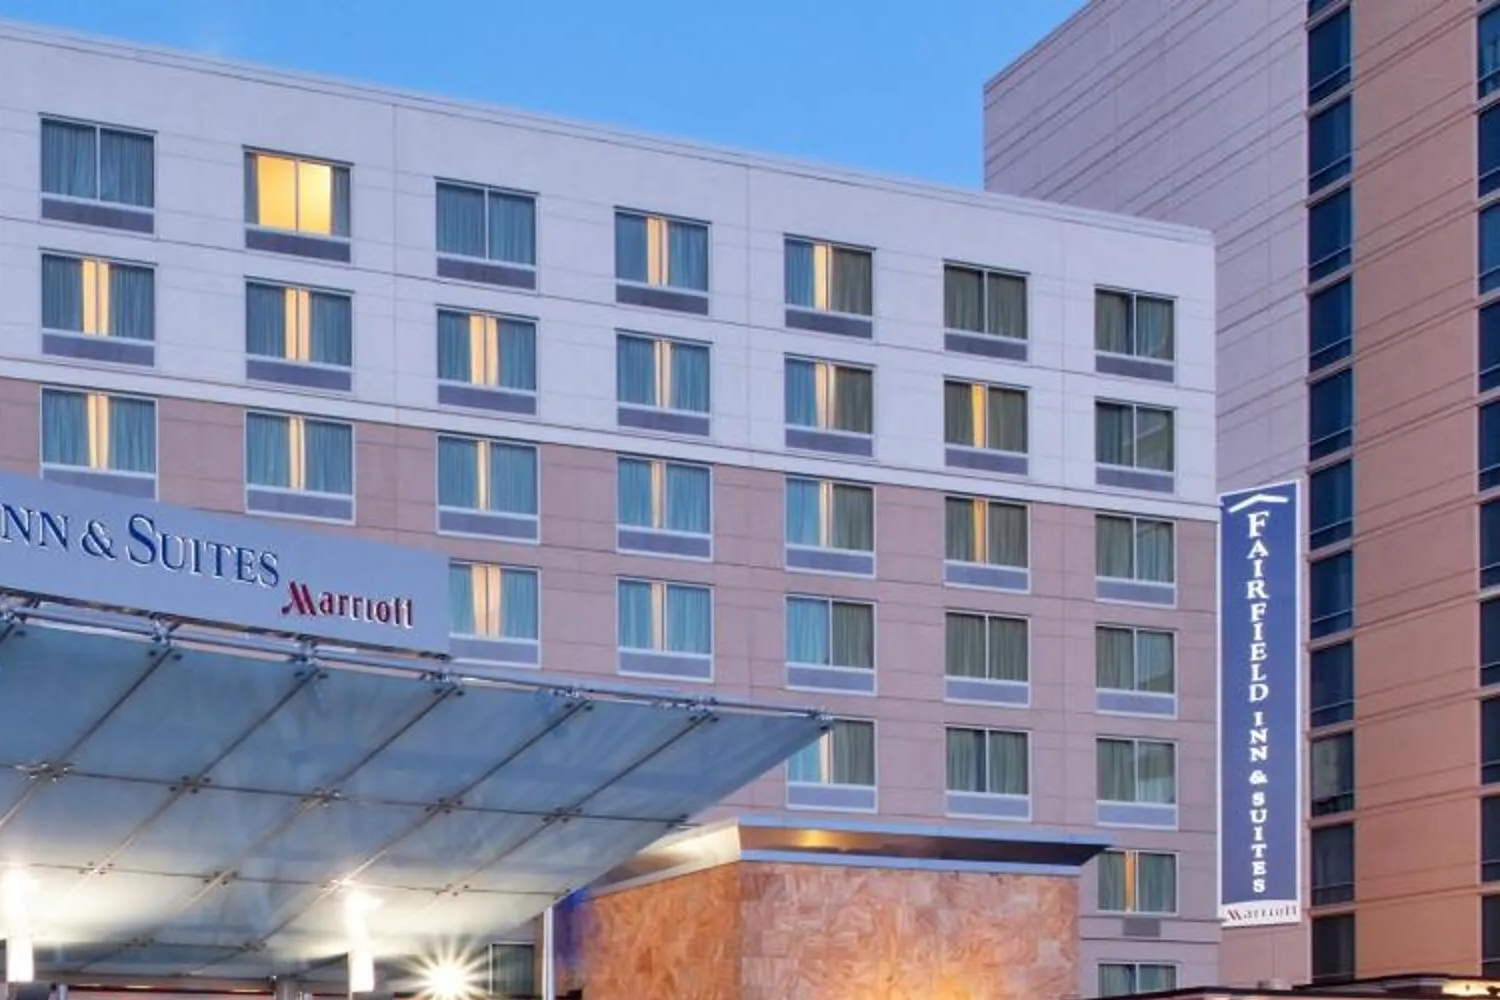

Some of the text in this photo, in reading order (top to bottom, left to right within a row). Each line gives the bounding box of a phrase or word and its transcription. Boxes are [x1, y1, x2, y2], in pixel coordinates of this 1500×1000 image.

[81, 519, 117, 561] &
[127, 513, 280, 588] SUITES
[281, 580, 415, 629] Marriott
[1247, 511, 1270, 894] FAIRFIELD INN & SUITES
